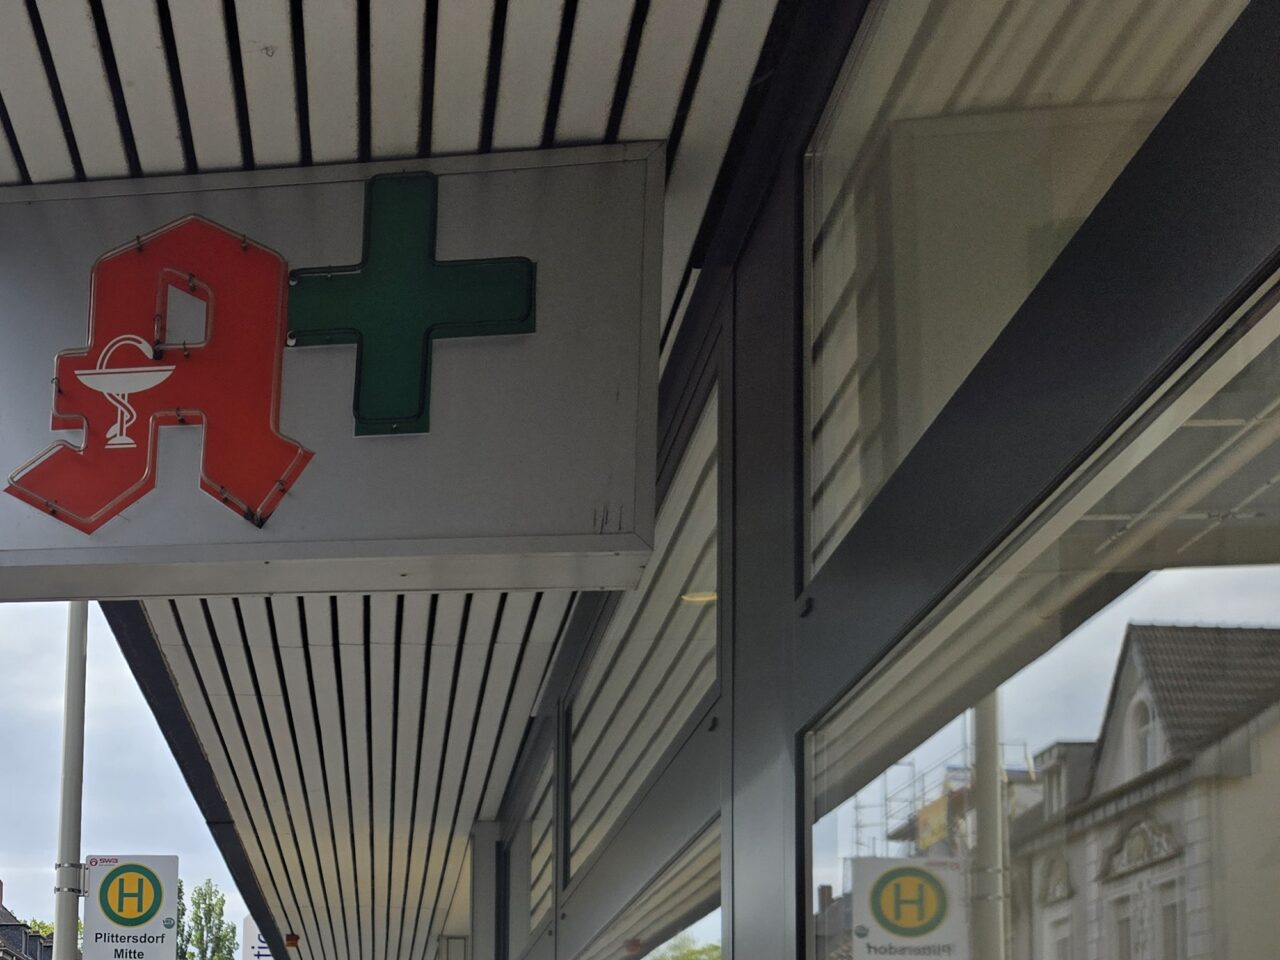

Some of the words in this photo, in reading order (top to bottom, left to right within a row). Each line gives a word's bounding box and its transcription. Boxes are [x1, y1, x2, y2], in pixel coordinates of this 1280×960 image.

[117, 878, 144, 913] H
[95, 932, 166, 944] Plittersdorf
[114, 948, 144, 959] Mitte
